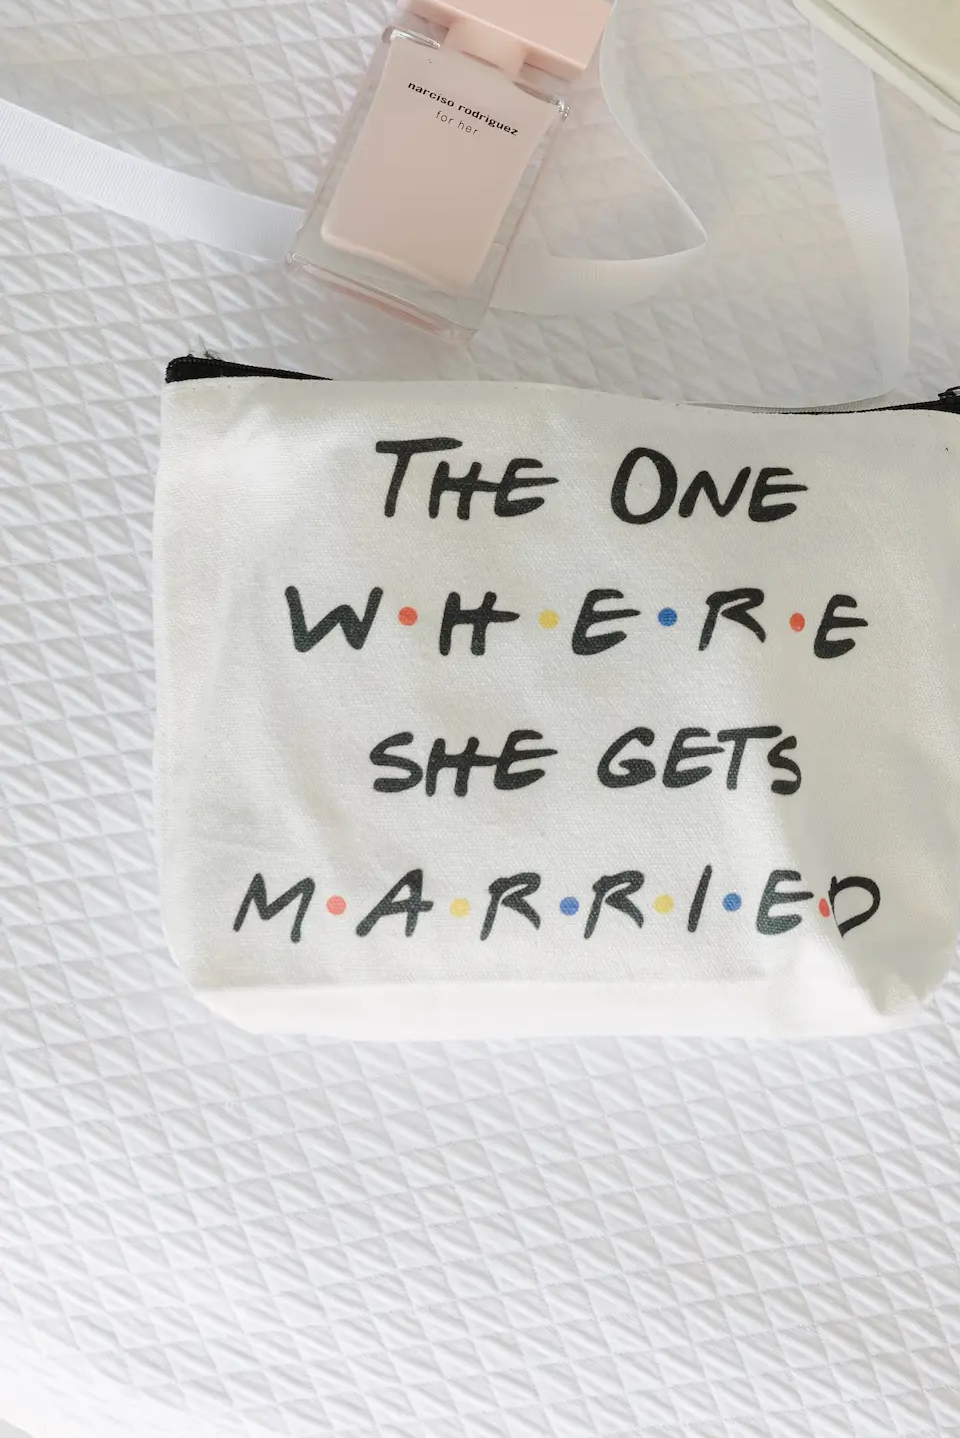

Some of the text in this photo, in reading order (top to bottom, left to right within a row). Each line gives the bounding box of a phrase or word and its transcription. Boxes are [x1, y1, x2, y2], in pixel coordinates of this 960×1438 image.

[408, 82, 519, 136] narciso rodriguez
[435, 111, 479, 136] for her
[375, 437, 809, 525] THE ONE
[369, 725, 802, 797] SHE GETS
